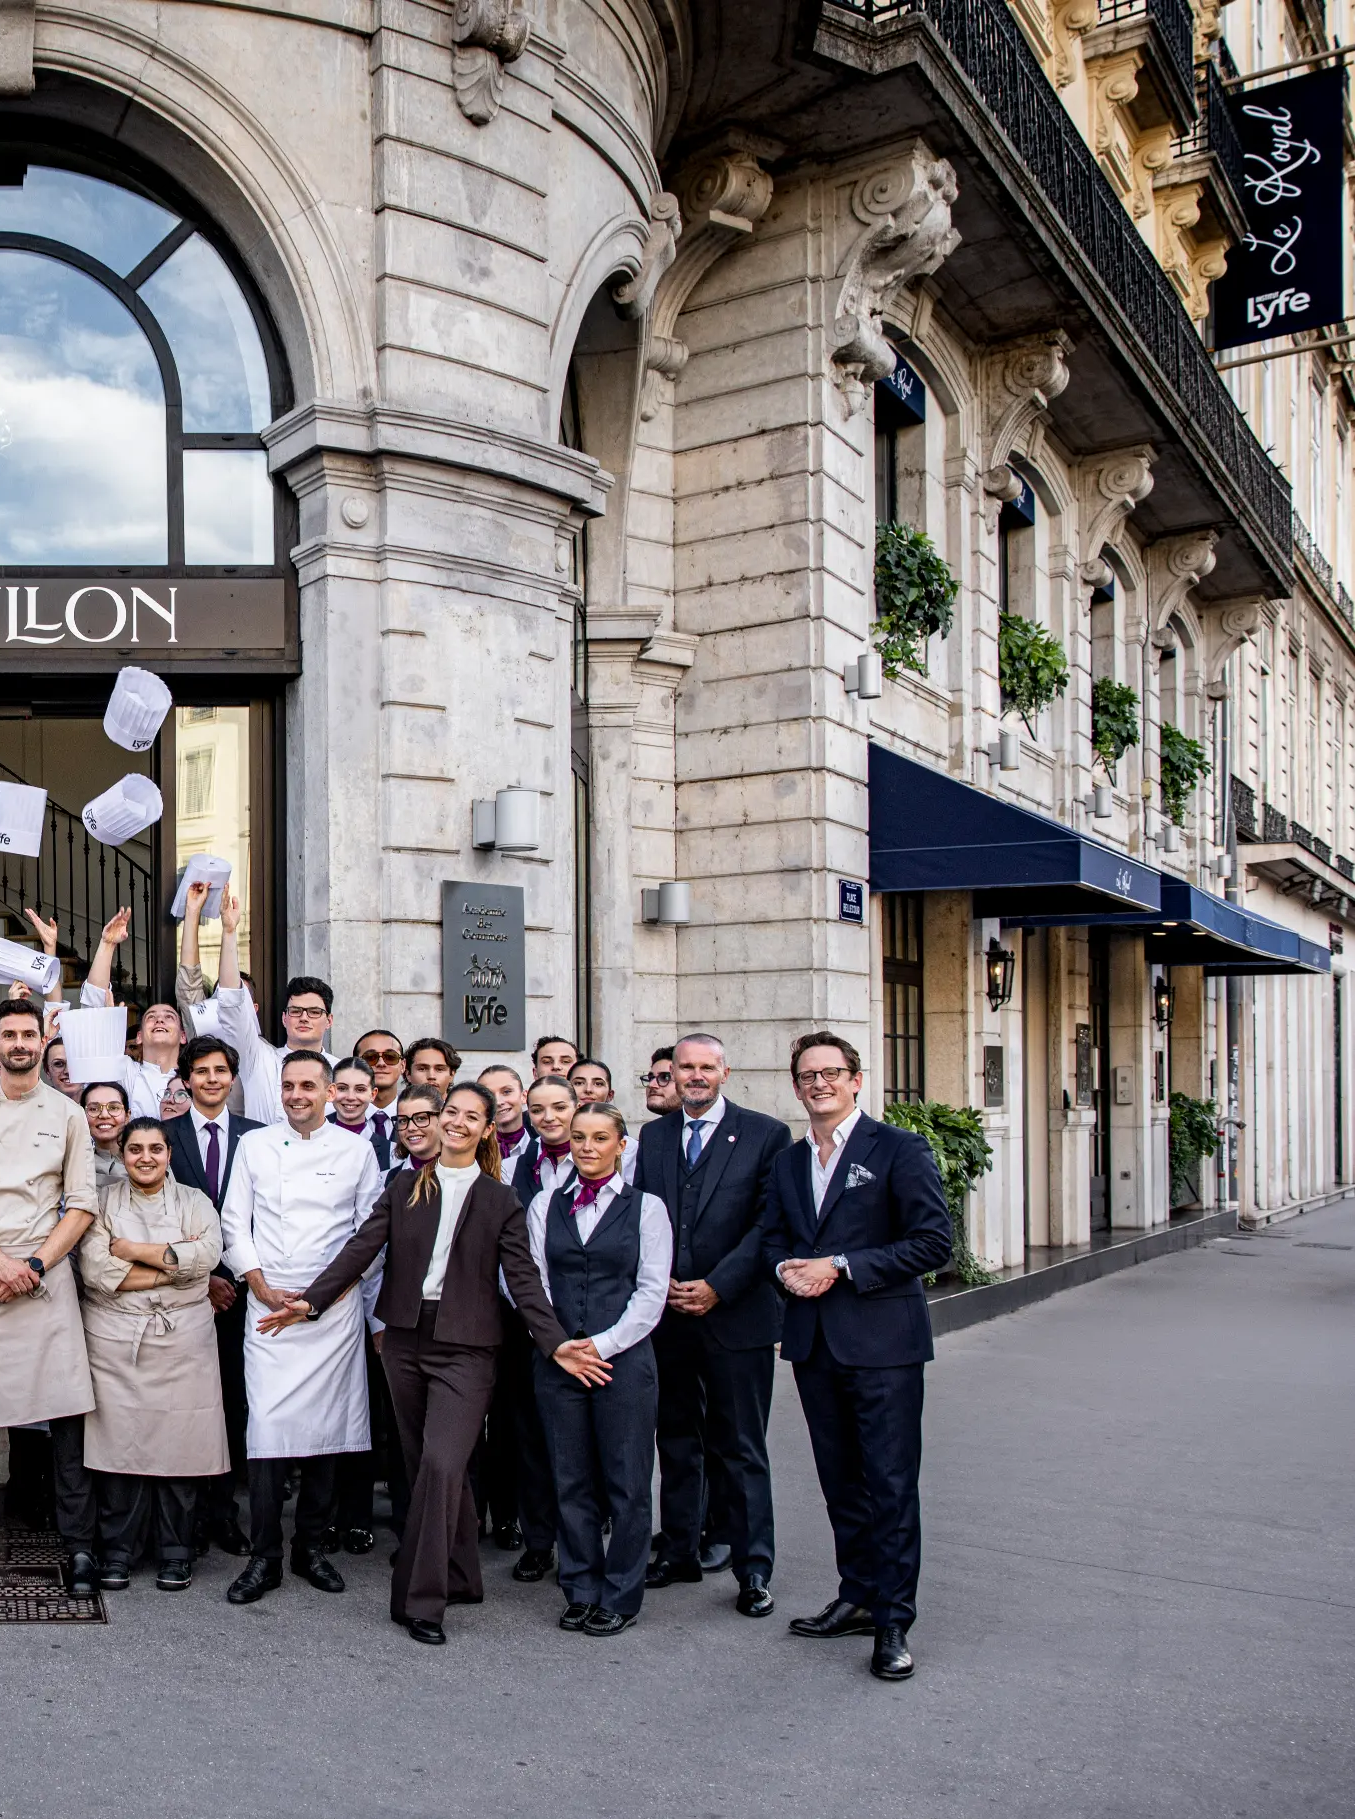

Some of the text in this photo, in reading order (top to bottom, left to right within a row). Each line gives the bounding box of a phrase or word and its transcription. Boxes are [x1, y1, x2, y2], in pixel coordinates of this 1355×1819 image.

[1242, 104, 1321, 275] Le Royal
[1247, 287, 1311, 329] Lyfe
[464, 994, 508, 1034] Lyfe
